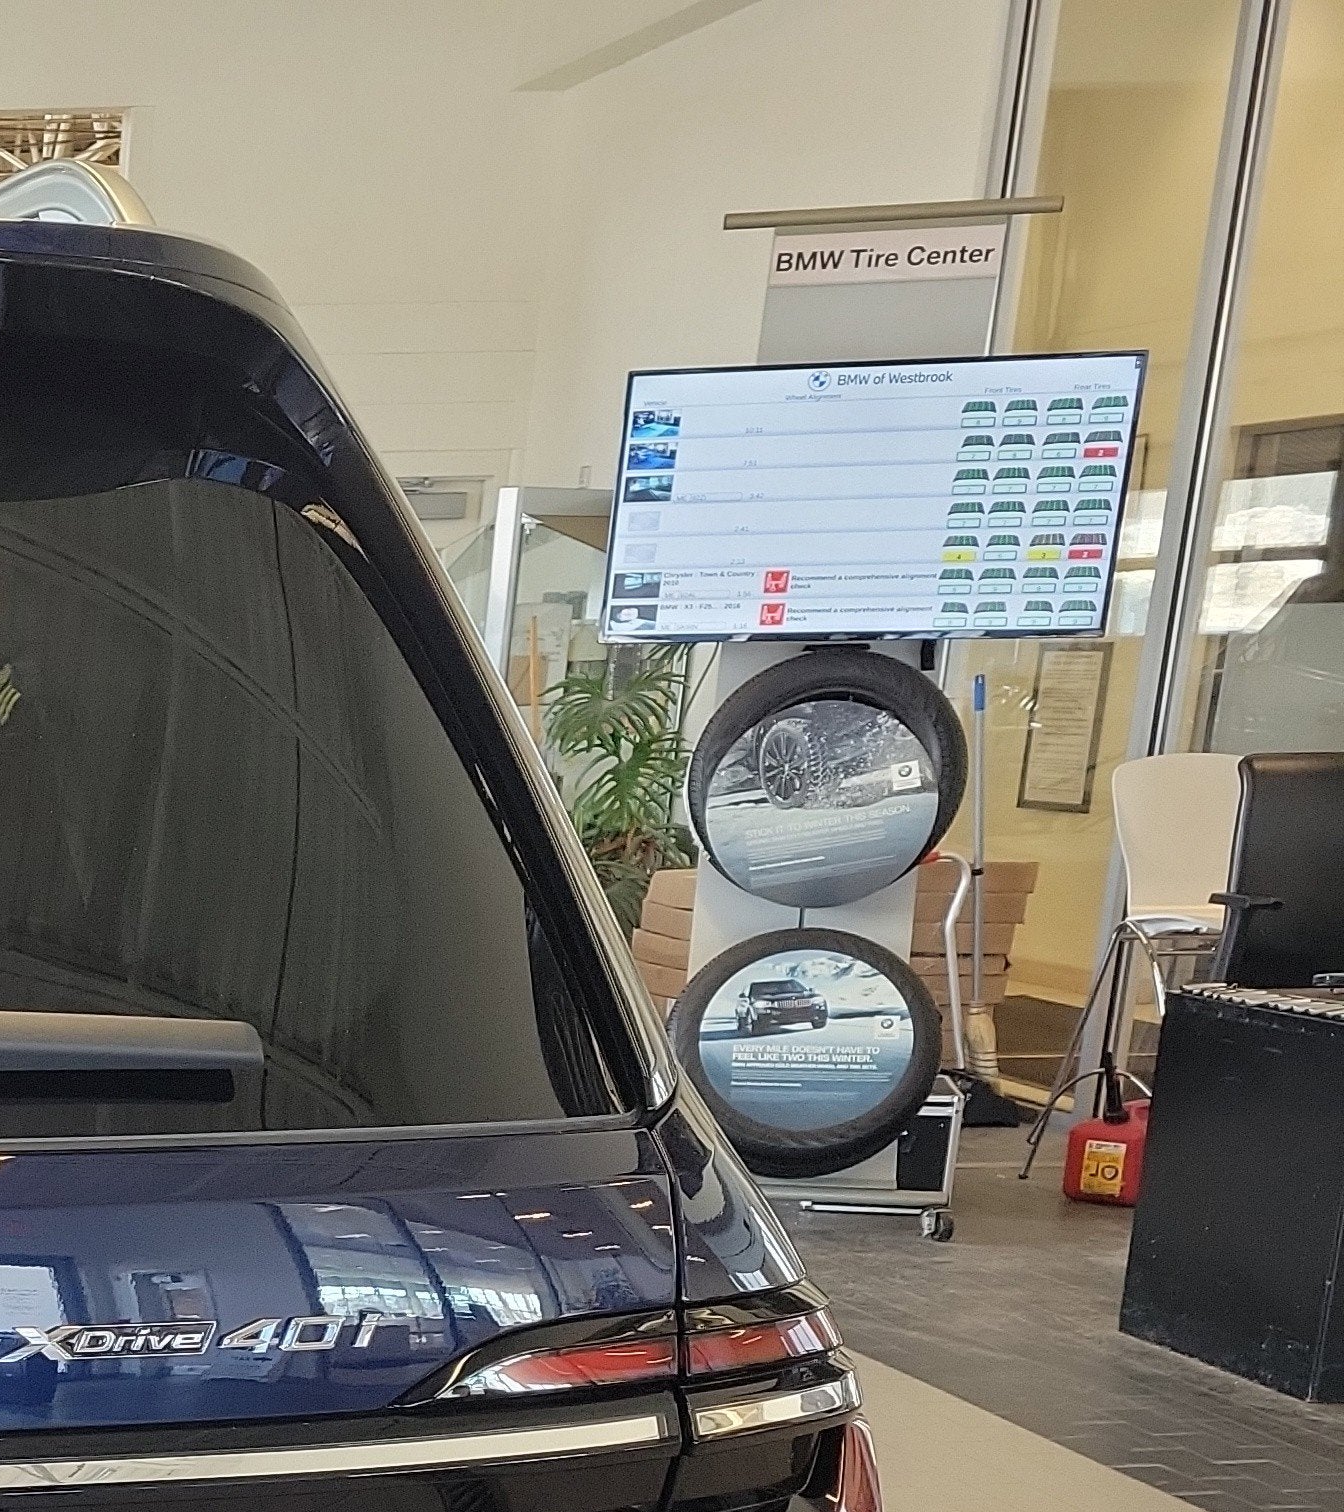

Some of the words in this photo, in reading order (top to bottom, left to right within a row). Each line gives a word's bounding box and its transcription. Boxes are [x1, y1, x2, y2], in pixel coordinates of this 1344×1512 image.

[775, 250, 845, 272] BMW
[850, 248, 899, 269] Tire
[906, 245, 996, 266] Center
[837, 373, 871, 386] BMW
[873, 372, 887, 385] of
[888, 371, 953, 384] Westbrook
[664, 571, 693, 579] Chrysler
[727, 570, 755, 578] Country
[844, 573, 900, 581] comprehensive
[901, 572, 938, 581] alignment
[839, 606, 894, 614] comprehensive
[733, 1044, 765, 1053] EVERY
[767, 1045, 791, 1053] MILE
[792, 1045, 834, 1054] DOESN'T
[836, 1046, 864, 1054] HAVE
[866, 1046, 880, 1055] TO
[732, 1053, 756, 1061] FEEL
[758, 1053, 780, 1061] LIKE
[782, 1053, 805, 1062] TWO
[808, 1054, 830, 1062] THIS
[832, 1054, 873, 1063] WINTER.
